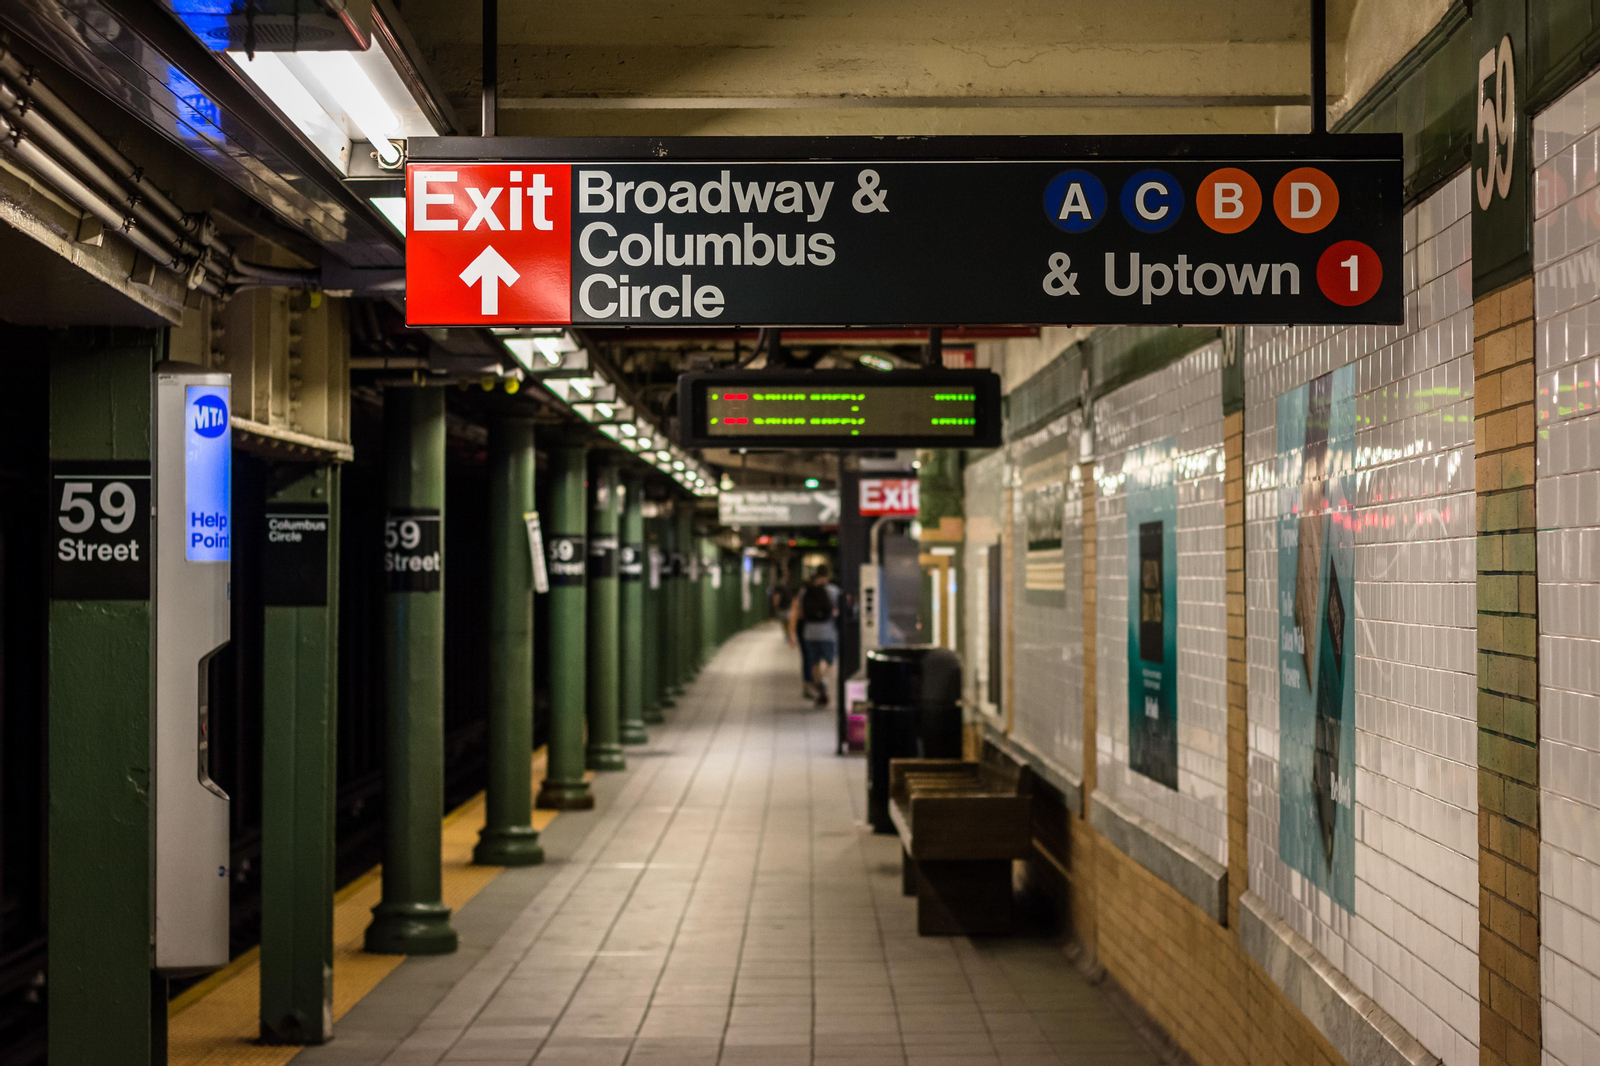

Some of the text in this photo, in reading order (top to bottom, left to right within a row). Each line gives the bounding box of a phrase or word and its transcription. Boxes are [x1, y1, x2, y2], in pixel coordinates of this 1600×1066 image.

[1476, 34, 1516, 211] 59
[413, 170, 553, 231] Exit
[578, 169, 889, 222] Broadway &
[1058, 181, 1321, 220] A C B D
[579, 222, 836, 267] Columbus
[579, 274, 725, 318] Circle
[1042, 252, 1359, 305] & Uptown 1
[193, 405, 224, 429] MTA
[58, 482, 136, 534] 59
[192, 511, 228, 531] Help
[269, 518, 326, 531] Columbus
[58, 539, 139, 562] Street
[269, 531, 302, 542] Circle
[384, 520, 421, 549] 59
[384, 551, 441, 572] Street
